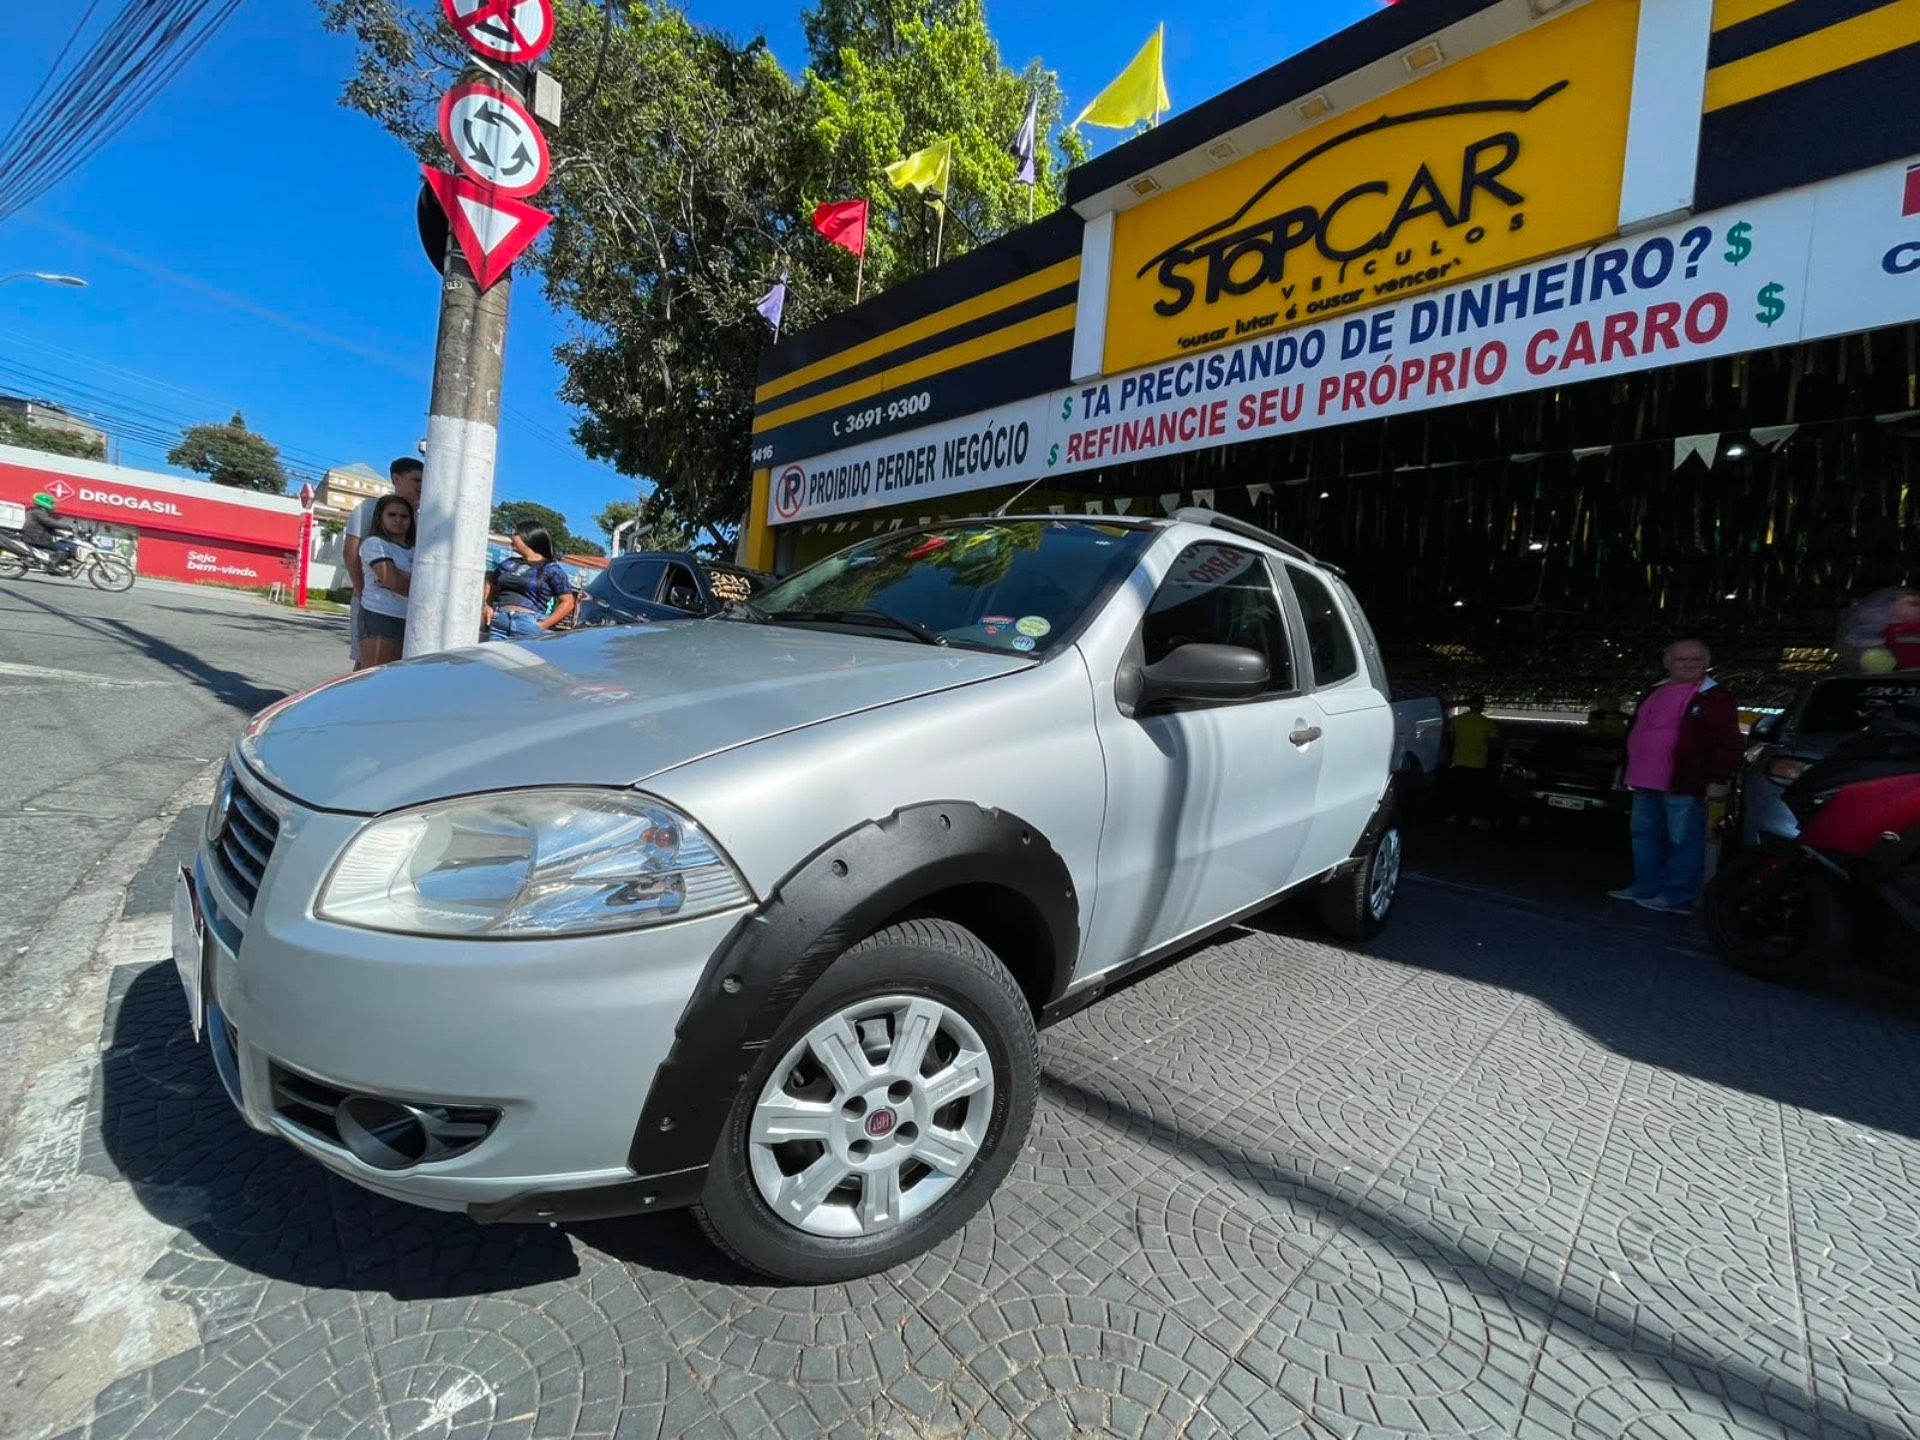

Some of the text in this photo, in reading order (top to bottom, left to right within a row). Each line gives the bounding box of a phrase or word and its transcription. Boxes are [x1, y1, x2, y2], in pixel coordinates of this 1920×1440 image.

[1081, 384, 1111, 420] TA
[1119, 329, 1326, 411] PRECISANDO
[1340, 310, 1396, 360] DE
[1409, 226, 1712, 345] DINHEIRO?
[1235, 312, 1278, 335] lutar
[1285, 303, 1297, 320] é
[1306, 288, 1364, 314] ousar
[1067, 400, 1229, 464] REFINANCIE
[1237, 383, 1304, 430] SEU
[1317, 340, 1508, 416] PRÓPRIO
[1525, 292, 1729, 376] CARRO
[845, 392, 931, 433] 3691-9300
[809, 420, 1029, 506] PROIBIDO PERDER NEGÓCIO
[79, 488, 183, 517] DROGASIL
[186, 561, 259, 578] bem-vindo.
[187, 551, 217, 564] Seja
